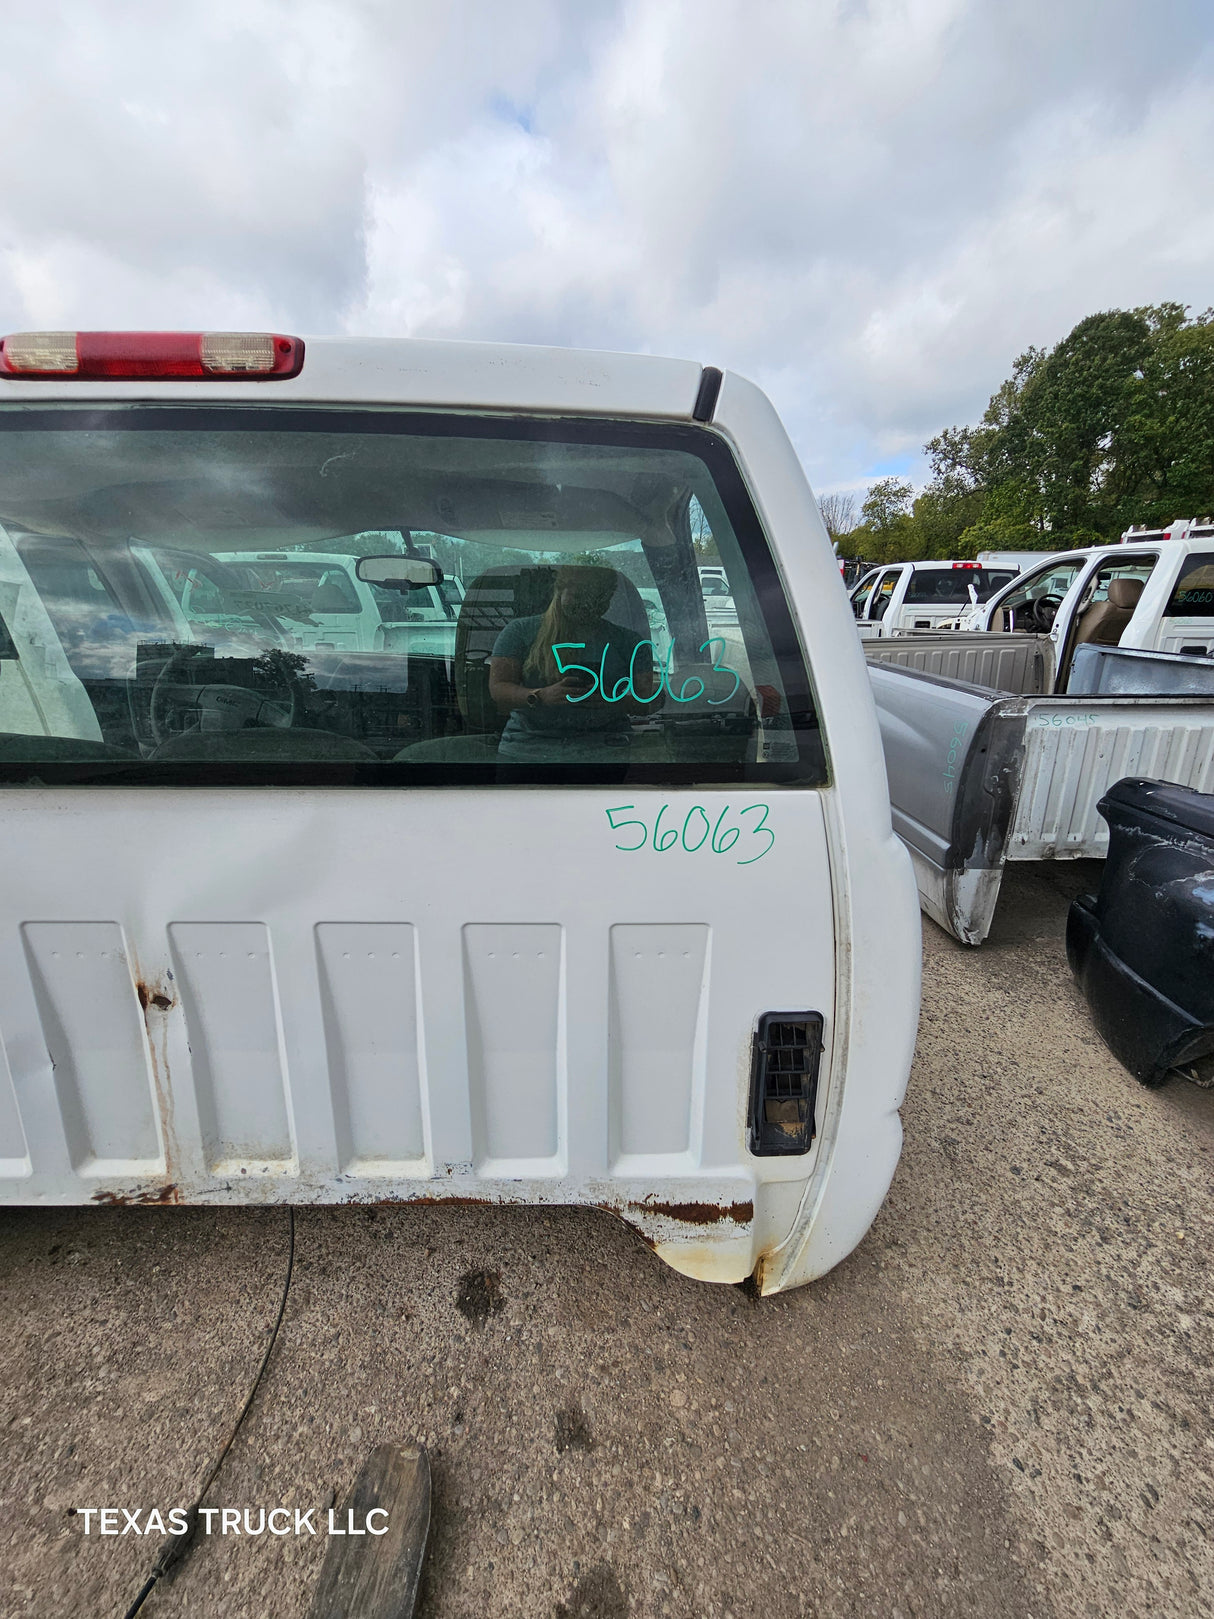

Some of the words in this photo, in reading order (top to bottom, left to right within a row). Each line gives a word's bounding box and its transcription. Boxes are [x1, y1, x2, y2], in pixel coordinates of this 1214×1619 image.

[1178, 590, 1213, 603] 56060
[552, 637, 740, 704] 56063
[1039, 713, 1099, 727] 56045
[943, 720, 969, 794] 56045
[606, 804, 775, 864] 56063
